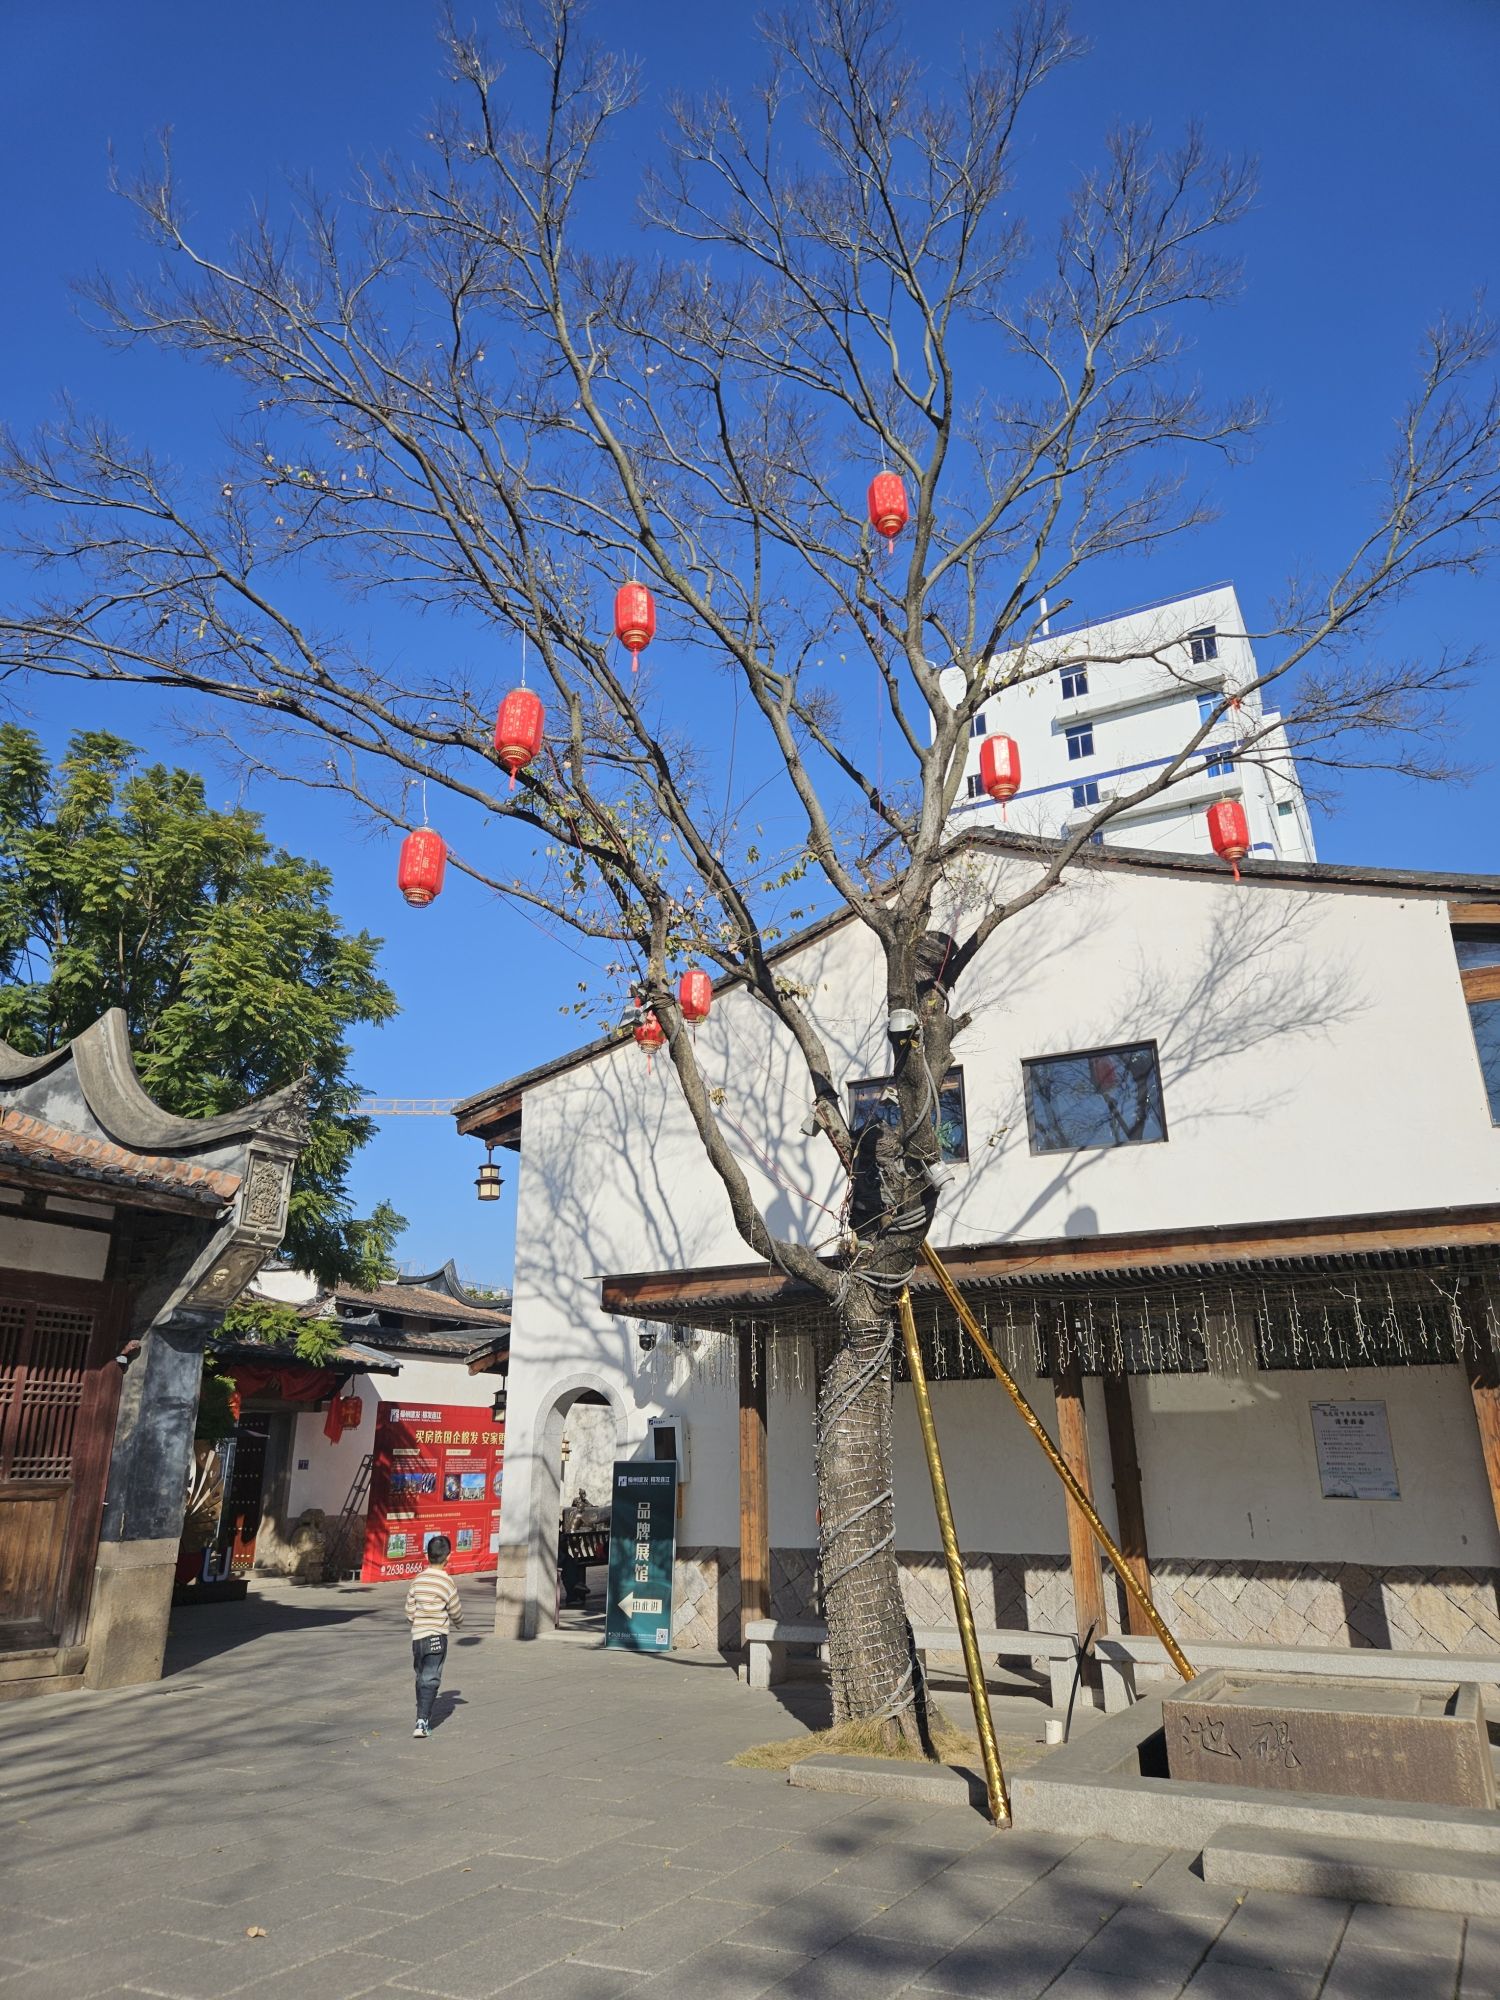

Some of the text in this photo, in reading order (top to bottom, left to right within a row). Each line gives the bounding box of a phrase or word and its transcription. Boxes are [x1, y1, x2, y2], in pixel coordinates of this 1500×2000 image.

[634, 1502, 650, 1582] 品牌展馆
[386, 1563, 404, 1576] 2638
